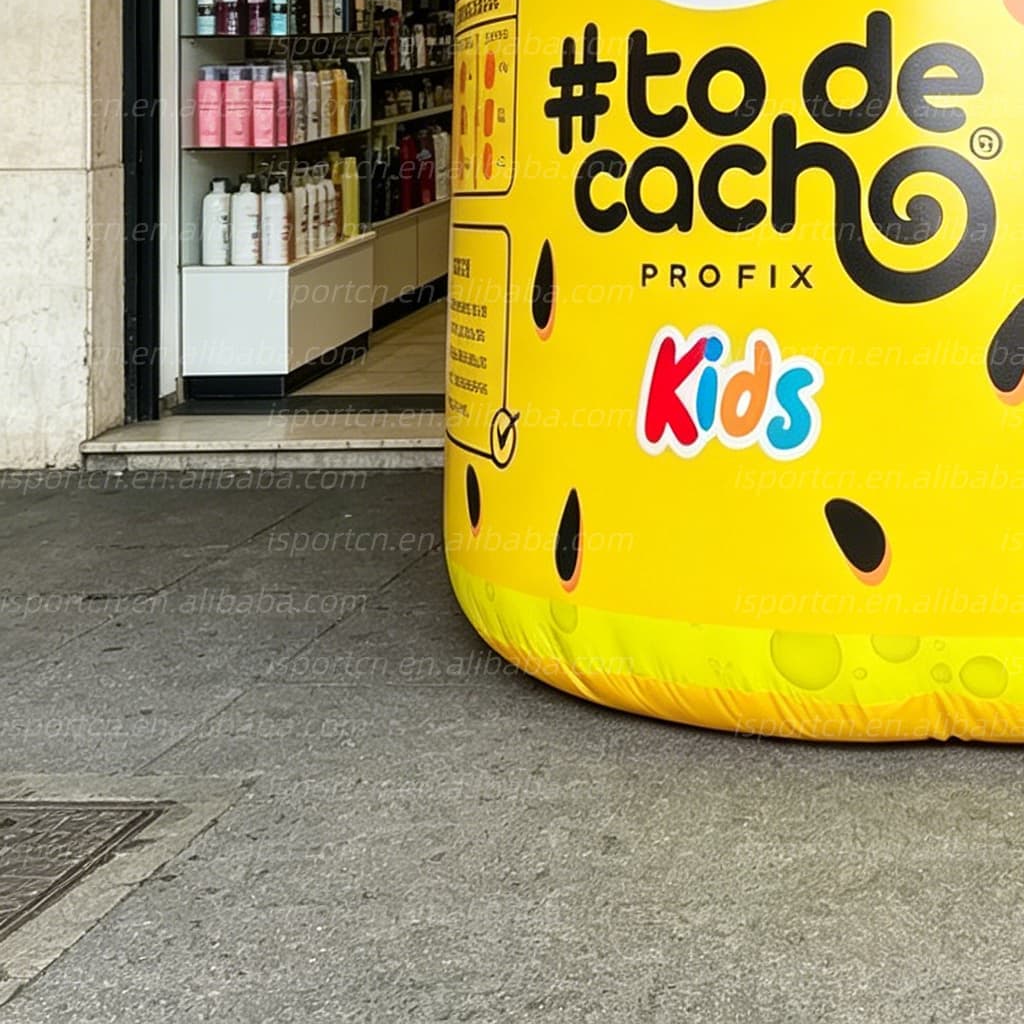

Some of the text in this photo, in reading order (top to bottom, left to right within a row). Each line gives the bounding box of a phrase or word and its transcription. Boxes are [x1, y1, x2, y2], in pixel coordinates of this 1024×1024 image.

[544, 10, 985, 154] #to de
[574, 113, 997, 304] cacho
[642, 334, 816, 453] Kids
